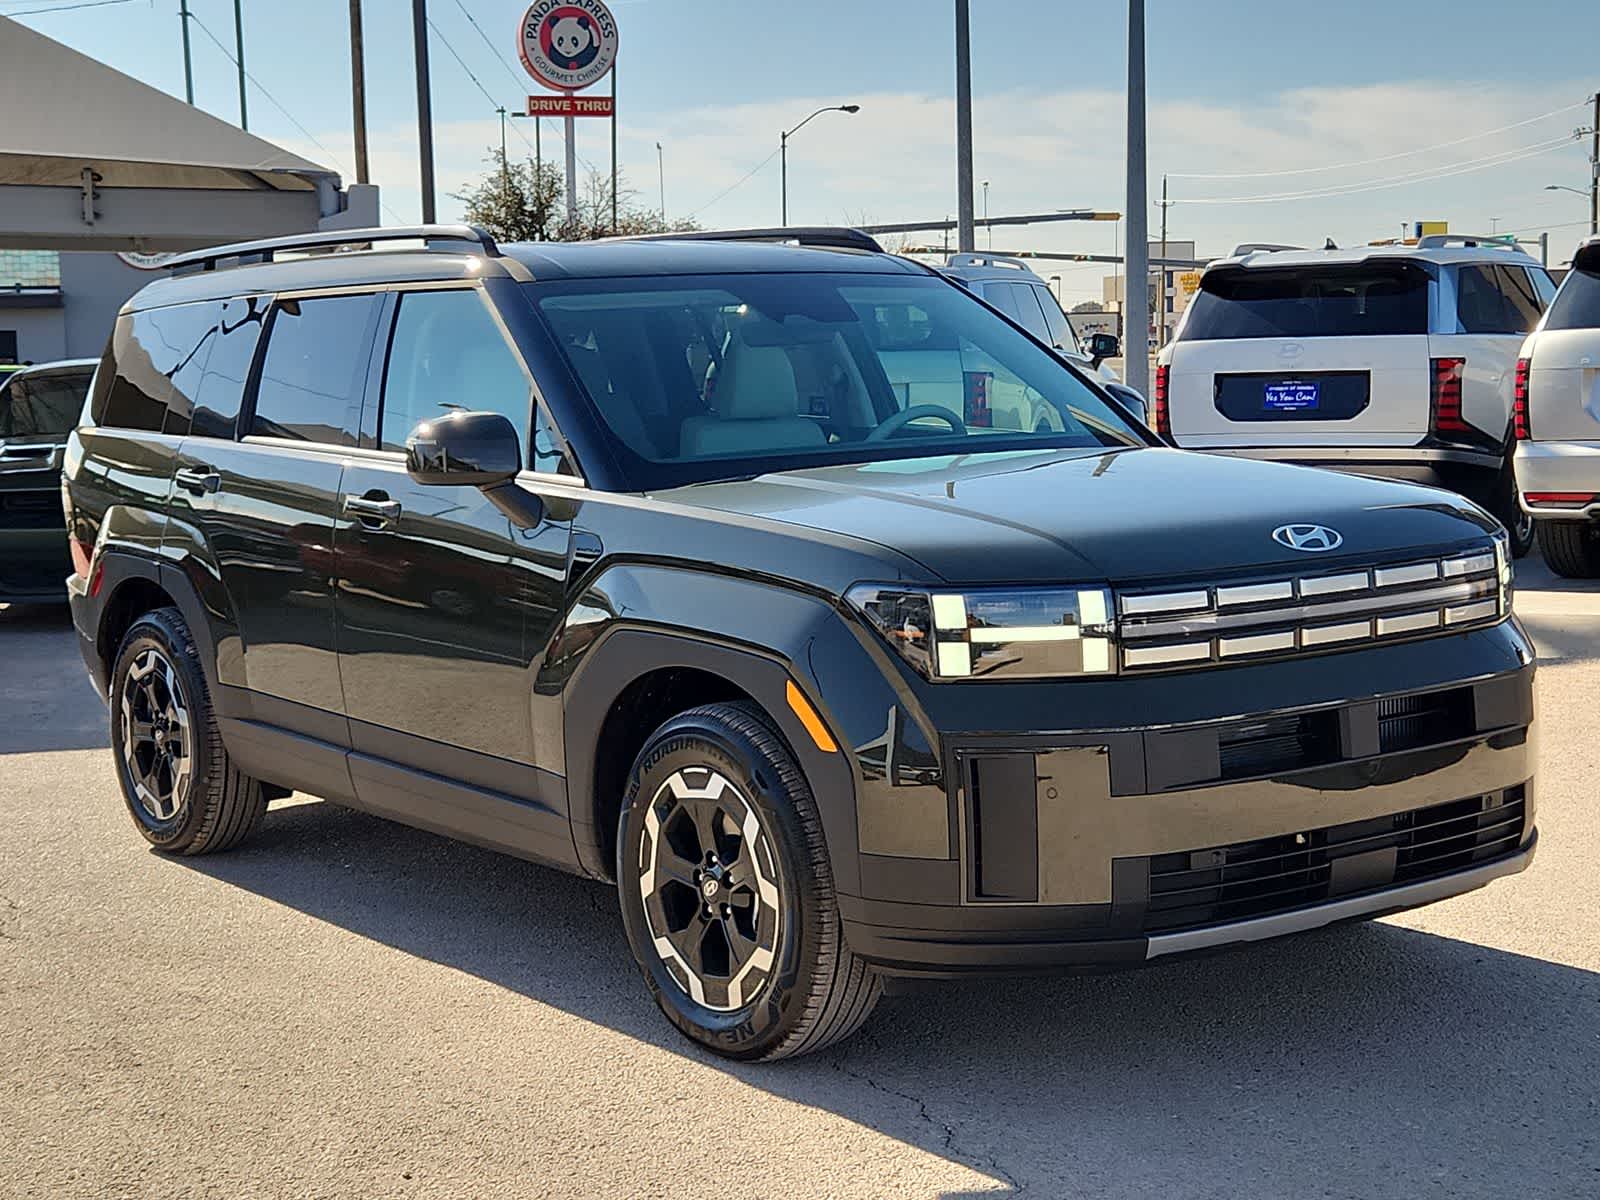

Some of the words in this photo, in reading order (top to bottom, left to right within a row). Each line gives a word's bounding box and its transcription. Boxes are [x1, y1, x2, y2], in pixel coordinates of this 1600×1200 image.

[526, 0, 560, 39] PANDA
[535, 55, 573, 82] GOURMET
[576, 57, 607, 82] CHINESE
[530, 100, 571, 111] DRIVE
[575, 100, 612, 111] THRU
[1279, 392, 1294, 401] You
[1295, 391, 1316, 401] Can!
